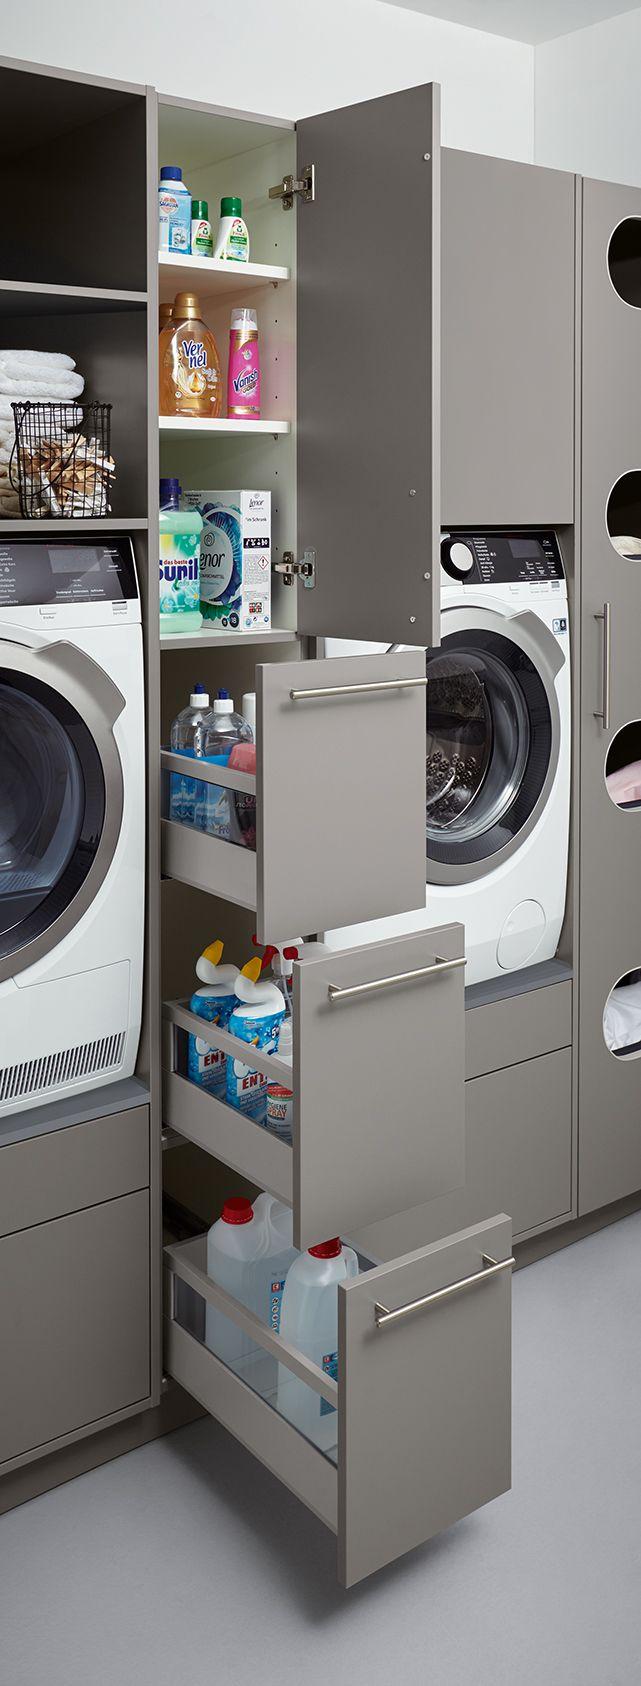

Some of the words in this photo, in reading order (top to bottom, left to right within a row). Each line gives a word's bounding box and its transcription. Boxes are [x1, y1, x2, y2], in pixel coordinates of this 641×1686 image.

[182, 340, 203, 357] Ver
[189, 350, 206, 368] nel
[233, 368, 258, 392] Vanish
[200, 553, 225, 570] enor
